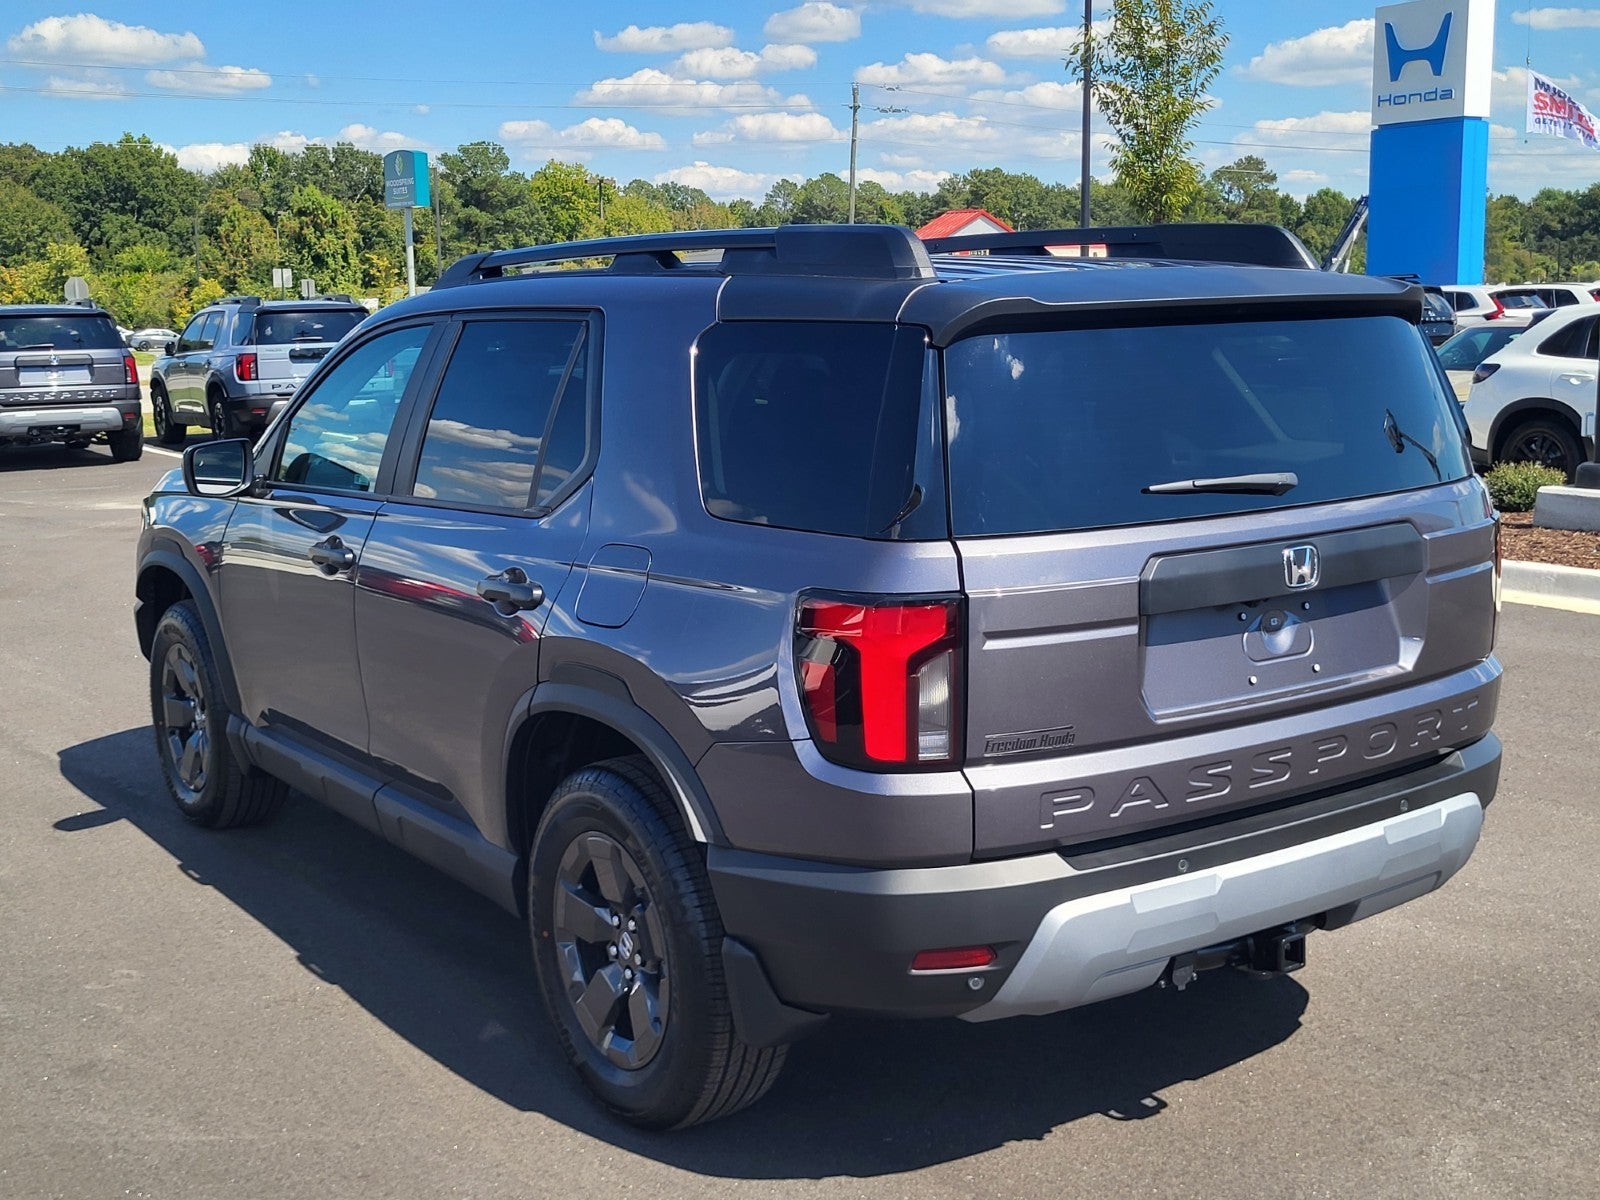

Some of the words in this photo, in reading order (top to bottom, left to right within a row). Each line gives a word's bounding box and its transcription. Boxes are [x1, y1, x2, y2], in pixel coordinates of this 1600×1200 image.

[1377, 87, 1455, 107] Honda
[984, 738, 1037, 753] Freedom
[1040, 732, 1075, 748] Honda
[1039, 695, 1480, 830] PASSPORT
